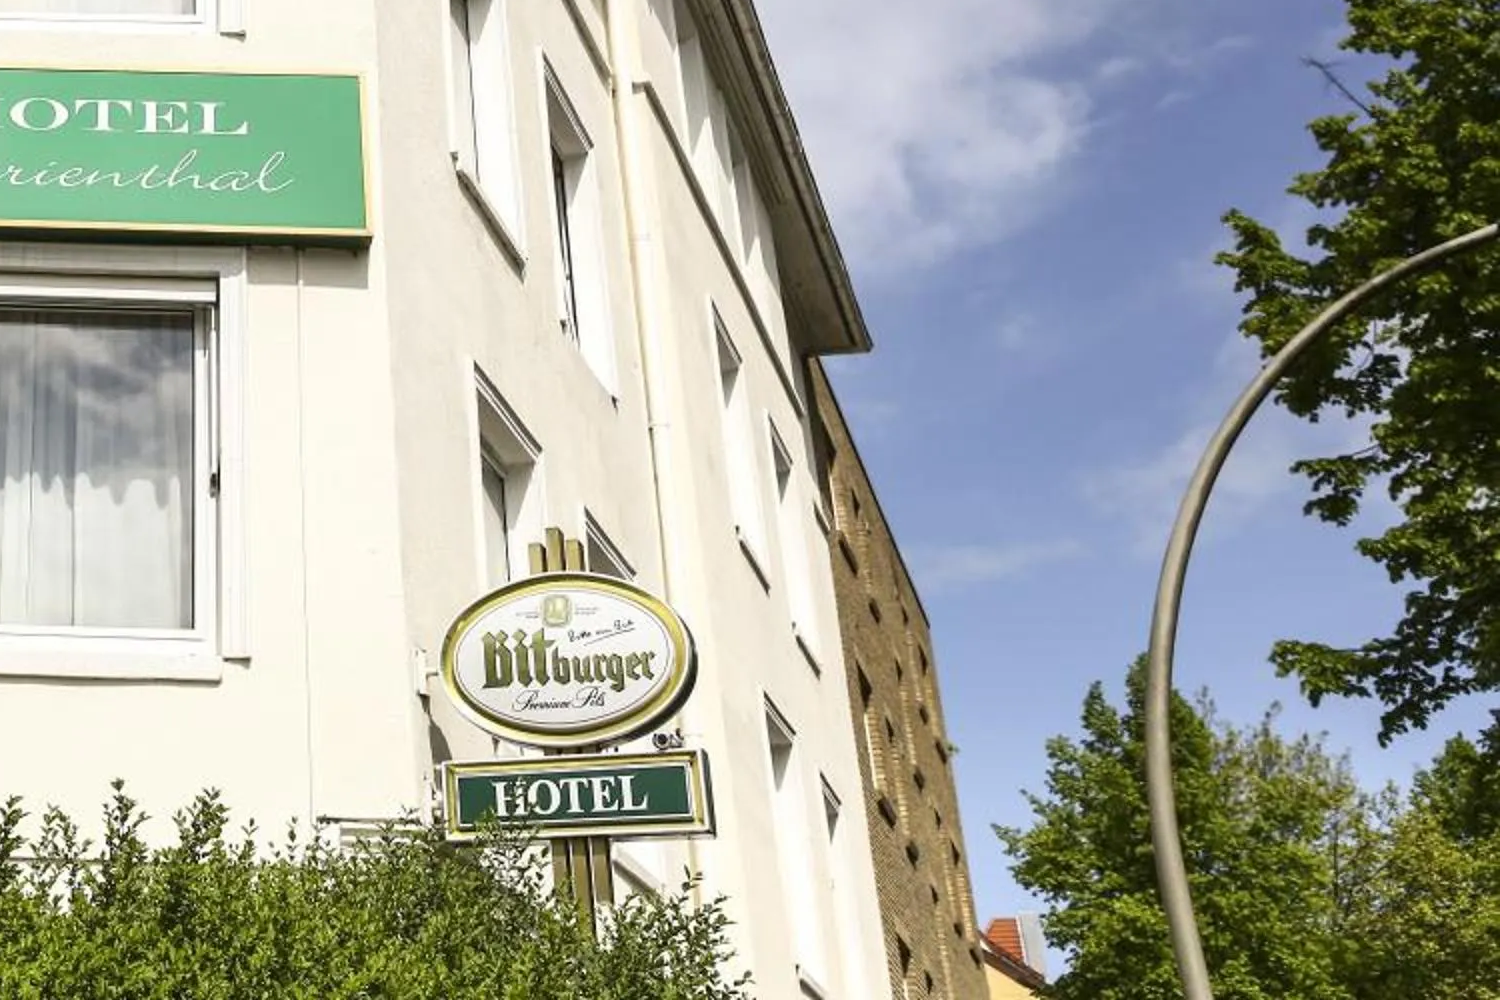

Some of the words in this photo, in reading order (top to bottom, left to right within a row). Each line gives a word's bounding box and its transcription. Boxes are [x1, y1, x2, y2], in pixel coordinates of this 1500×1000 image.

[482, 628, 656, 692] Bitburger
[512, 689, 571, 712] Premium
[571, 685, 606, 709] Pils
[491, 775, 649, 817] HOTEL
